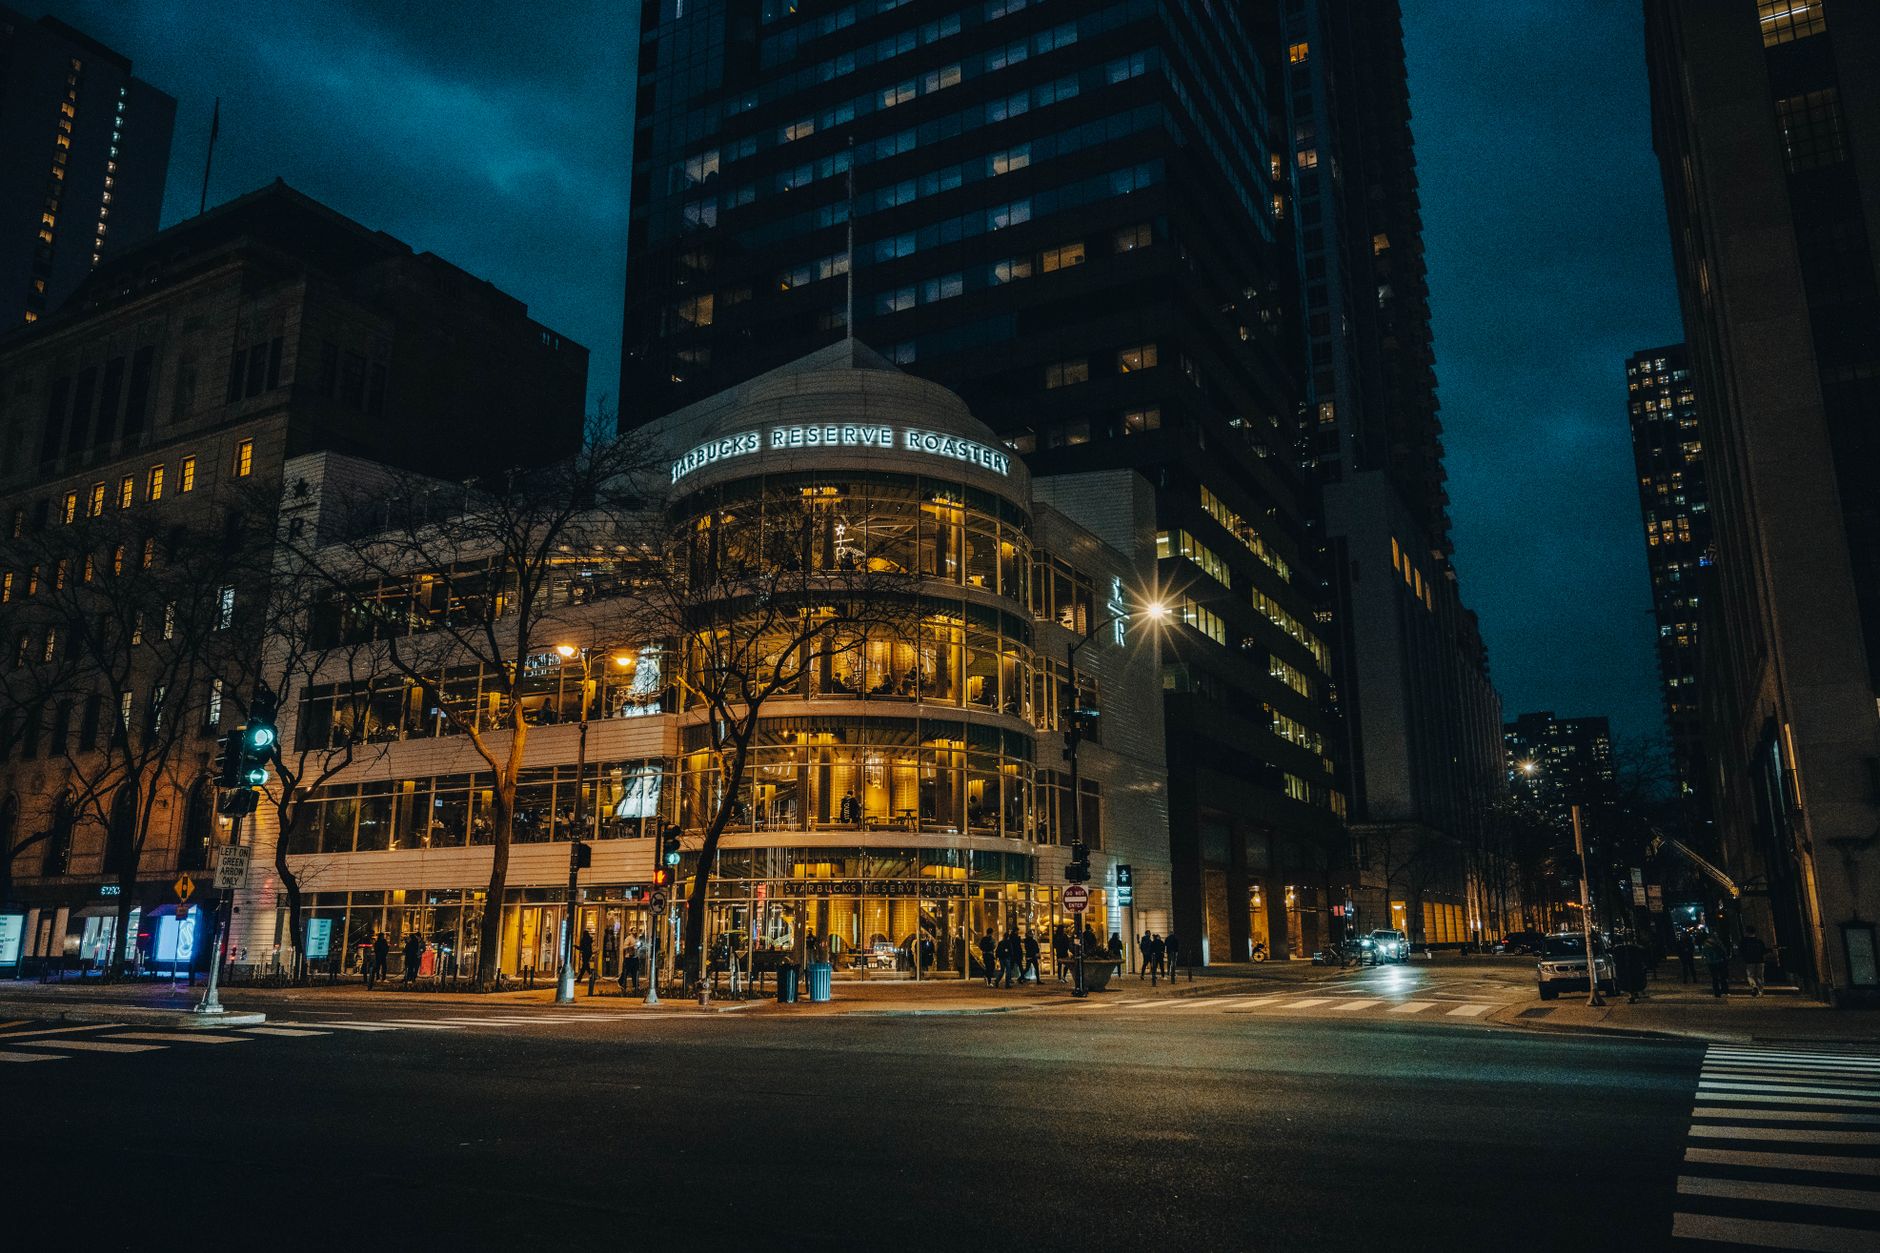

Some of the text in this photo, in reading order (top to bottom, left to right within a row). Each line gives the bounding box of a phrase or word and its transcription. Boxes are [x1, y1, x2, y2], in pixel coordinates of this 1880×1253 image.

[671, 427, 1011, 480] STARBUCKS RESERVE ROASTERY
[1115, 619, 1126, 647] R
[220, 847, 248, 857] LEFT ON
[222, 857, 244, 867] GREEN
[220, 867, 244, 876] ARROW
[221, 877, 239, 886] ONLY
[785, 884, 856, 893] STARBUCKS
